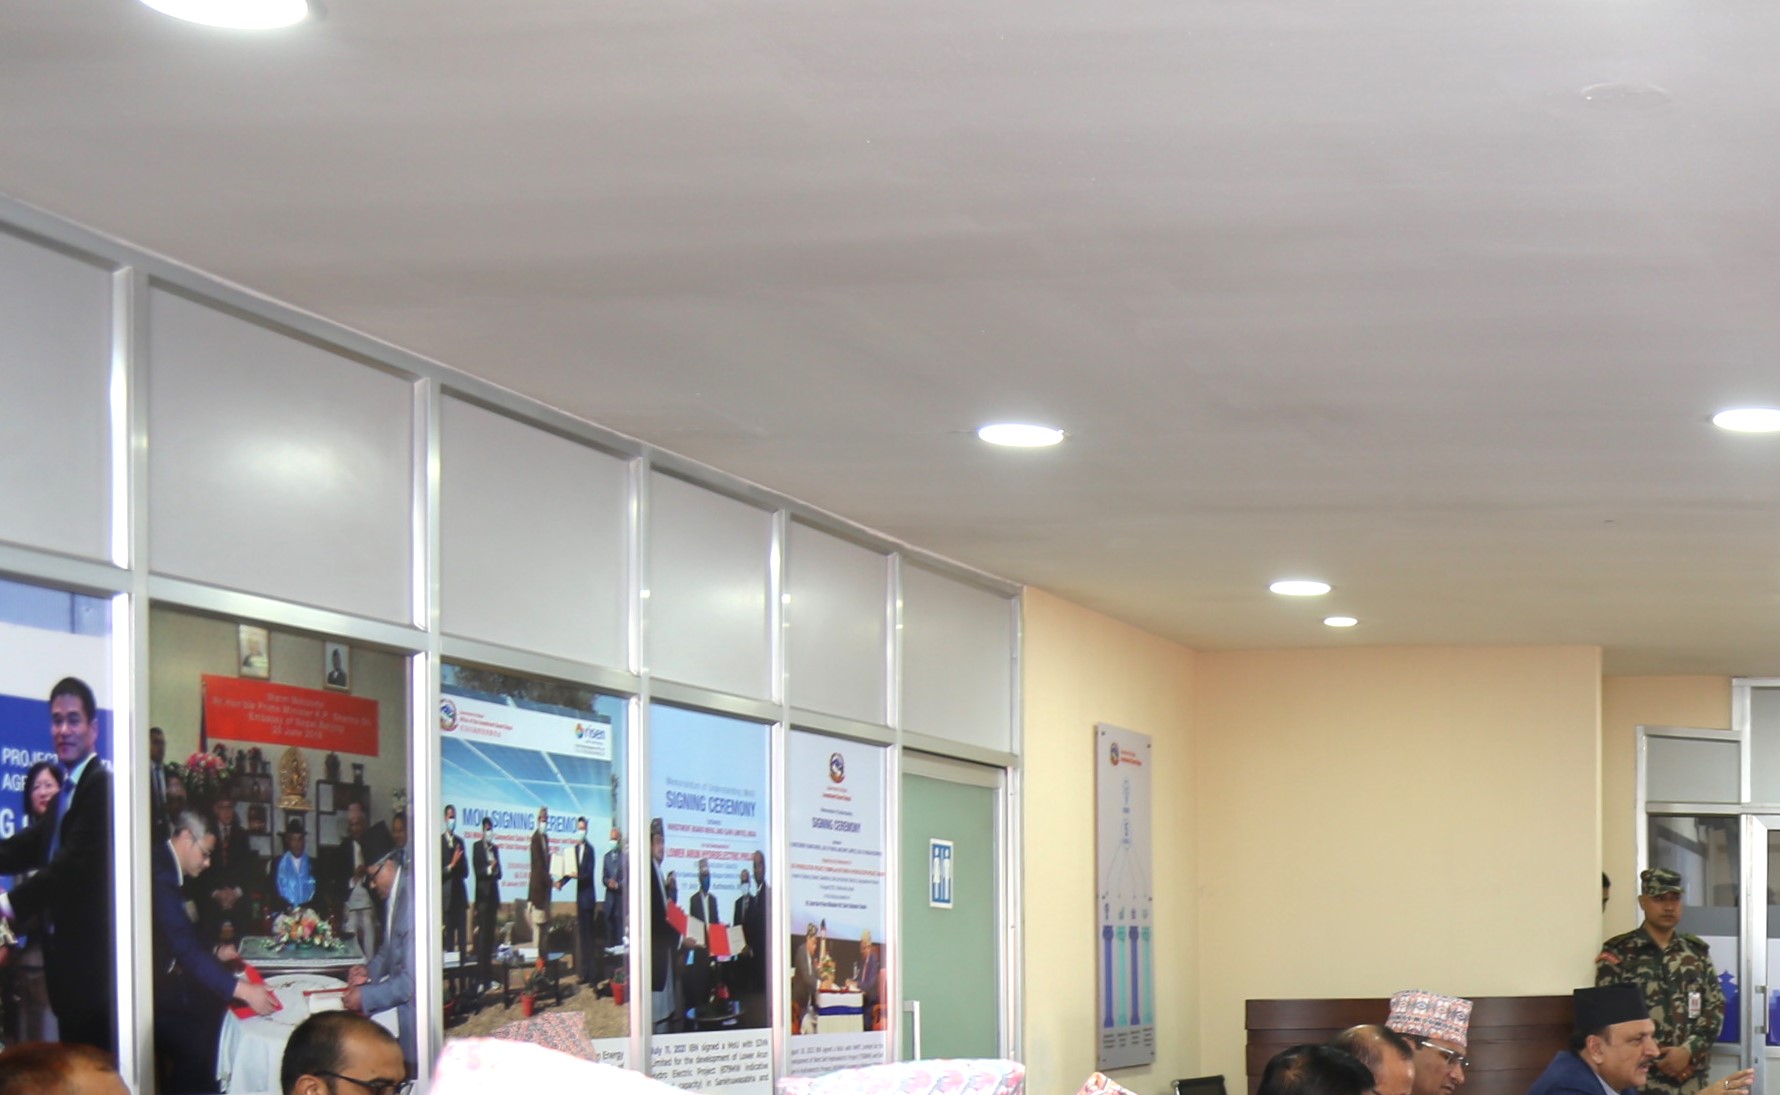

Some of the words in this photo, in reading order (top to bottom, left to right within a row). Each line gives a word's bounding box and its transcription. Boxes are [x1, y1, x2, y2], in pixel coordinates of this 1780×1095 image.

[585, 724, 606, 740] risen
[666, 790, 707, 812] SIGNING
[708, 795, 757, 817] CEREMONY
[491, 809, 535, 830] SIGNING
[812, 817, 834, 830] SIGNING
[834, 820, 861, 833] CEREMONY
